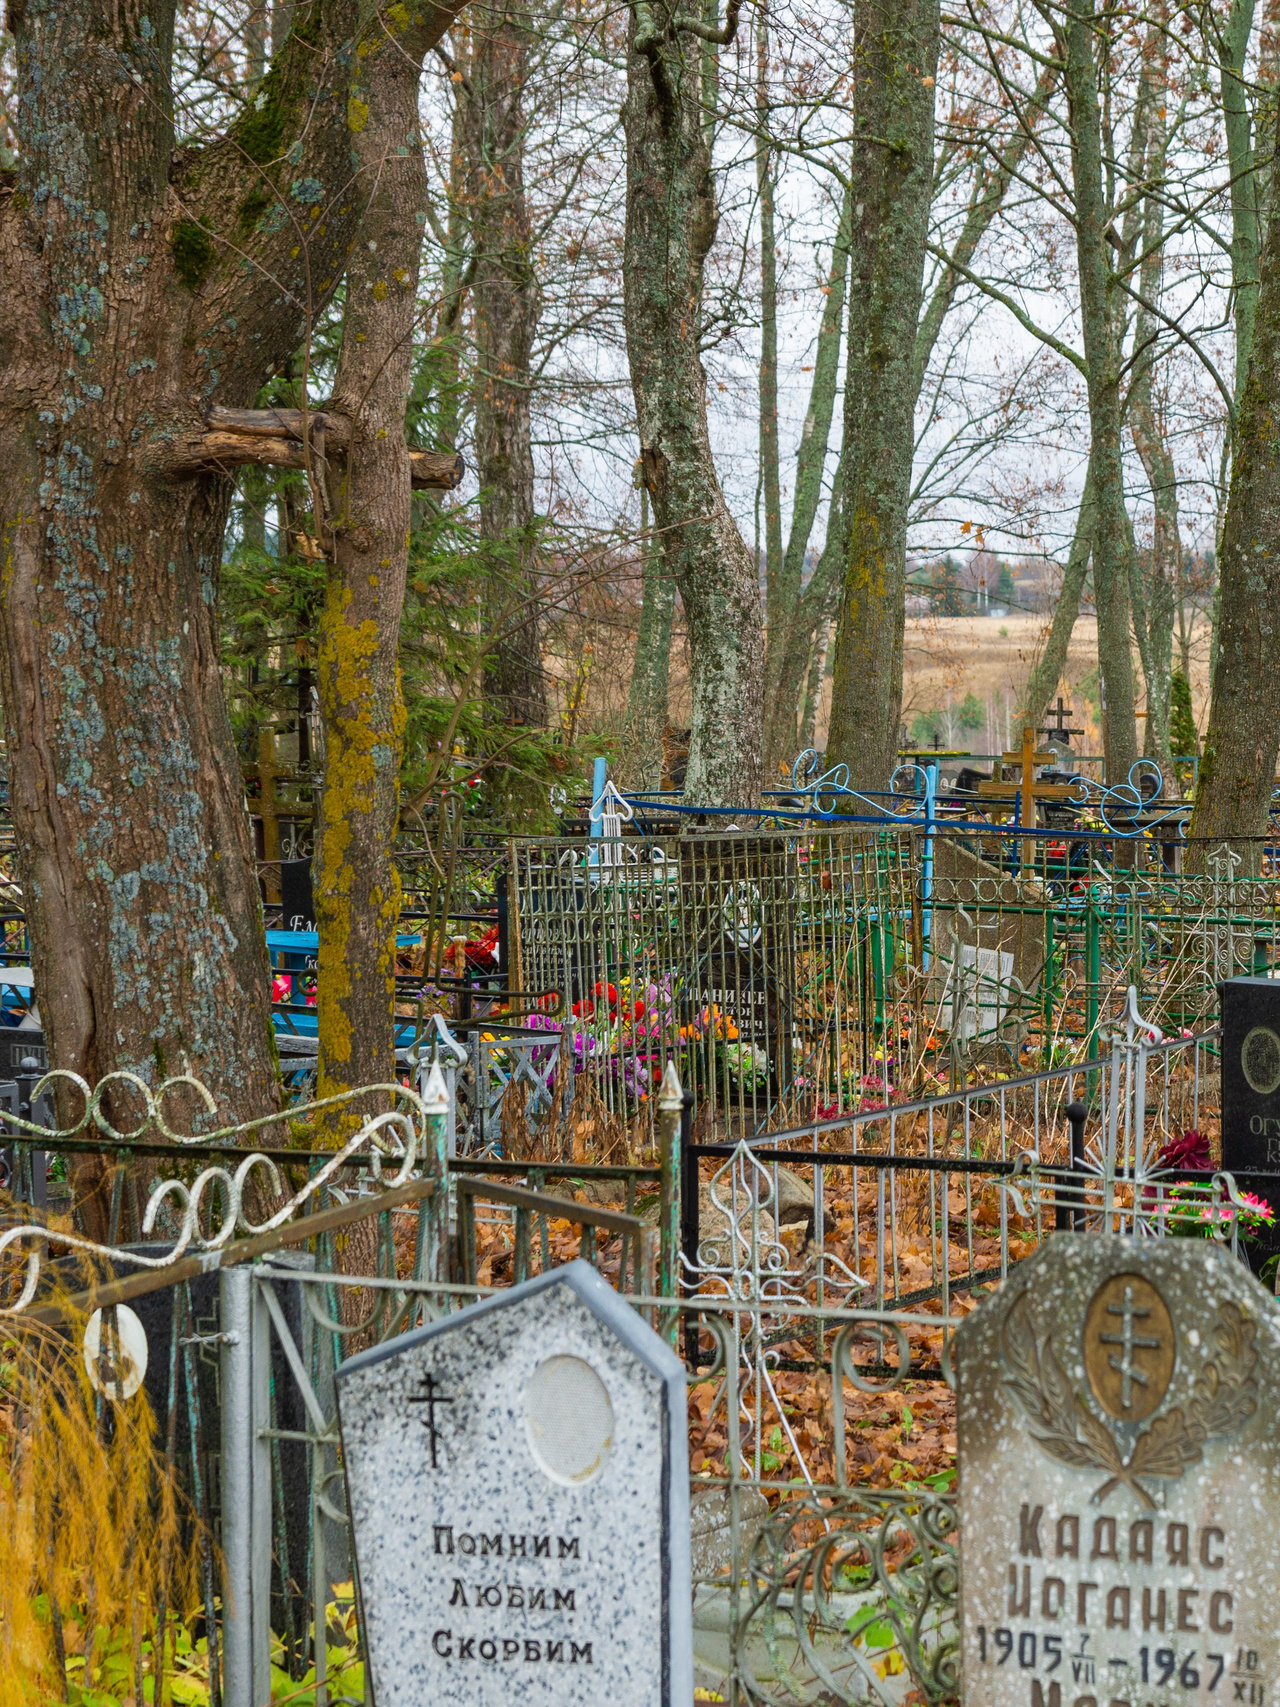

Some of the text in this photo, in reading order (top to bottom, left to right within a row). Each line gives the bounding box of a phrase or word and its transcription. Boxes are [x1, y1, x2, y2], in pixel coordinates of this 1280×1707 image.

[1018, 1504, 1225, 1570] КАДАЯС
[1008, 1563, 1234, 1635] ИОГАНЕС
[976, 1626, 1063, 1673] 1905
[1139, 1647, 1225, 1692] 1967
